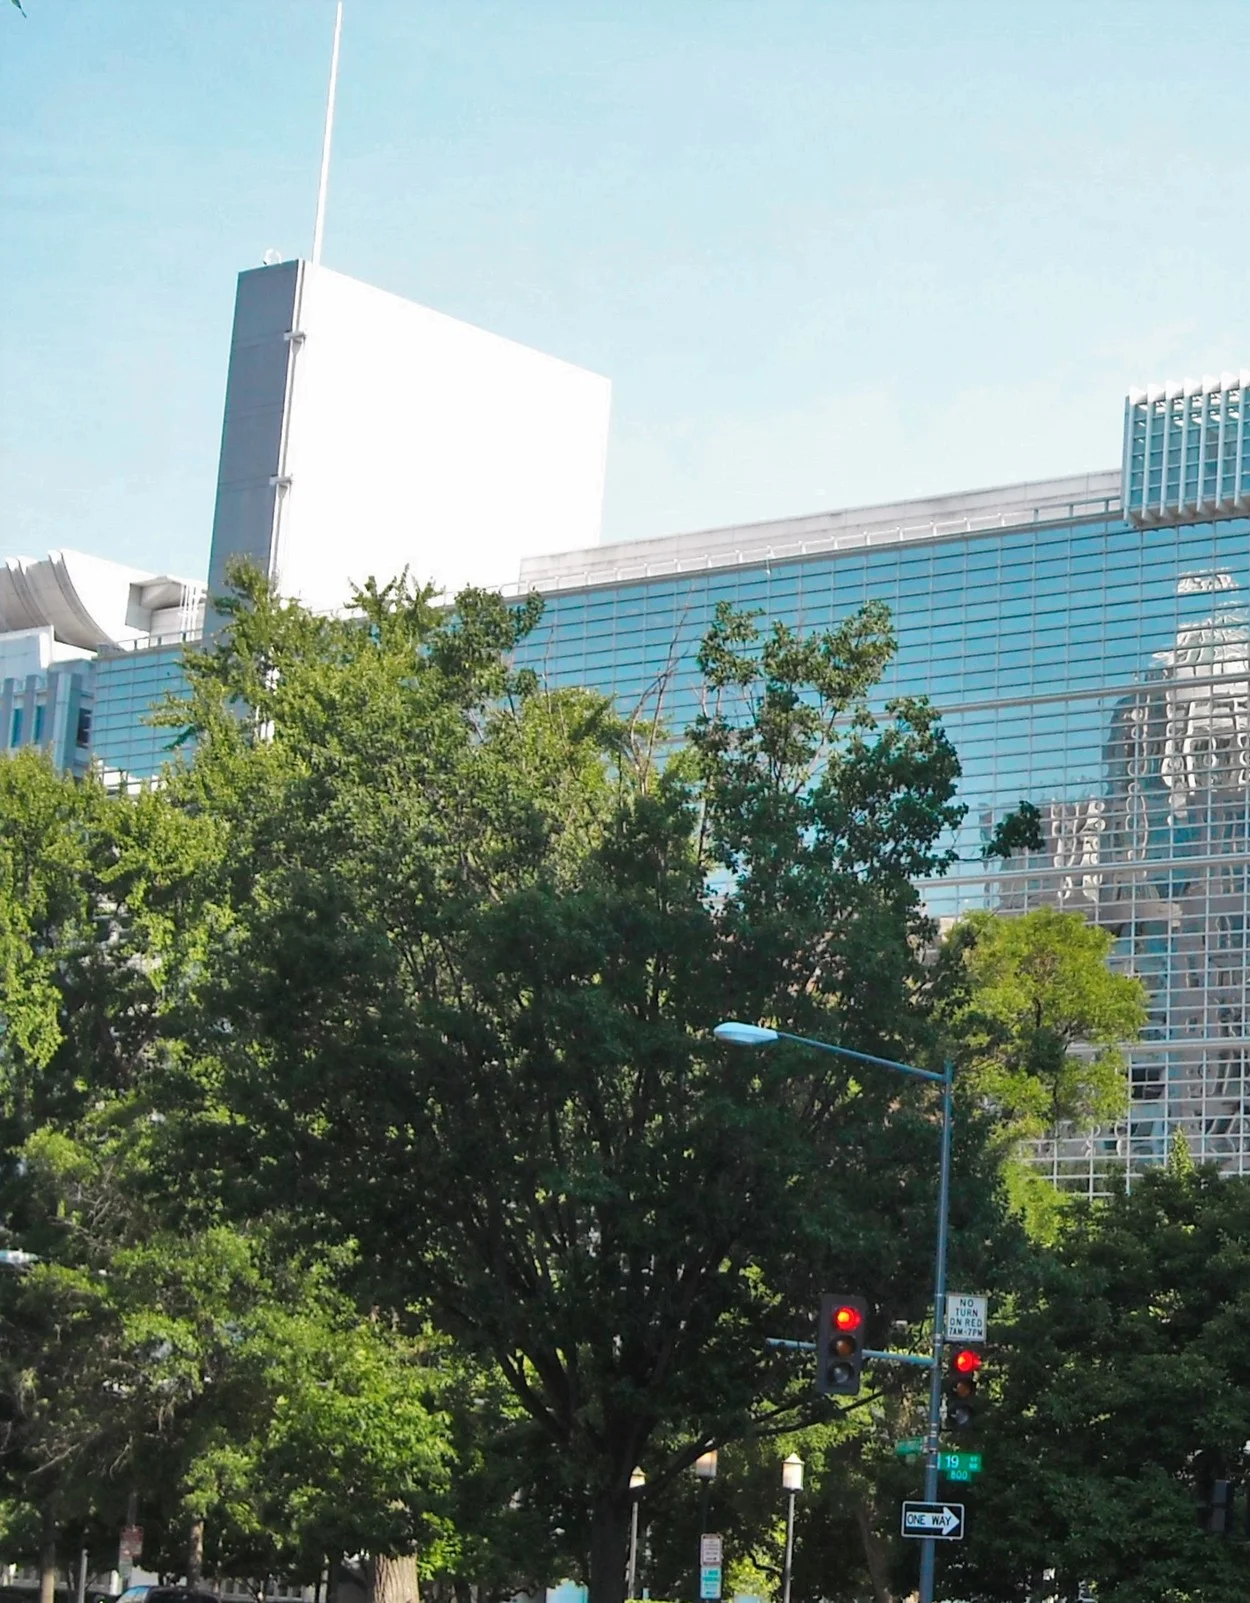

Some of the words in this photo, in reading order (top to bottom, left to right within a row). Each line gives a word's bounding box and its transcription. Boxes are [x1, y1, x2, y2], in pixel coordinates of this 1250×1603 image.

[960, 1298, 974, 1308] NO
[956, 1308, 978, 1317] TURN
[950, 1318, 962, 1326] ON
[965, 1318, 983, 1327] RED
[945, 1455, 960, 1469] 19
[950, 1471, 968, 1480] 800
[907, 1513, 926, 1525] ONE
[931, 1515, 952, 1526] WAY
